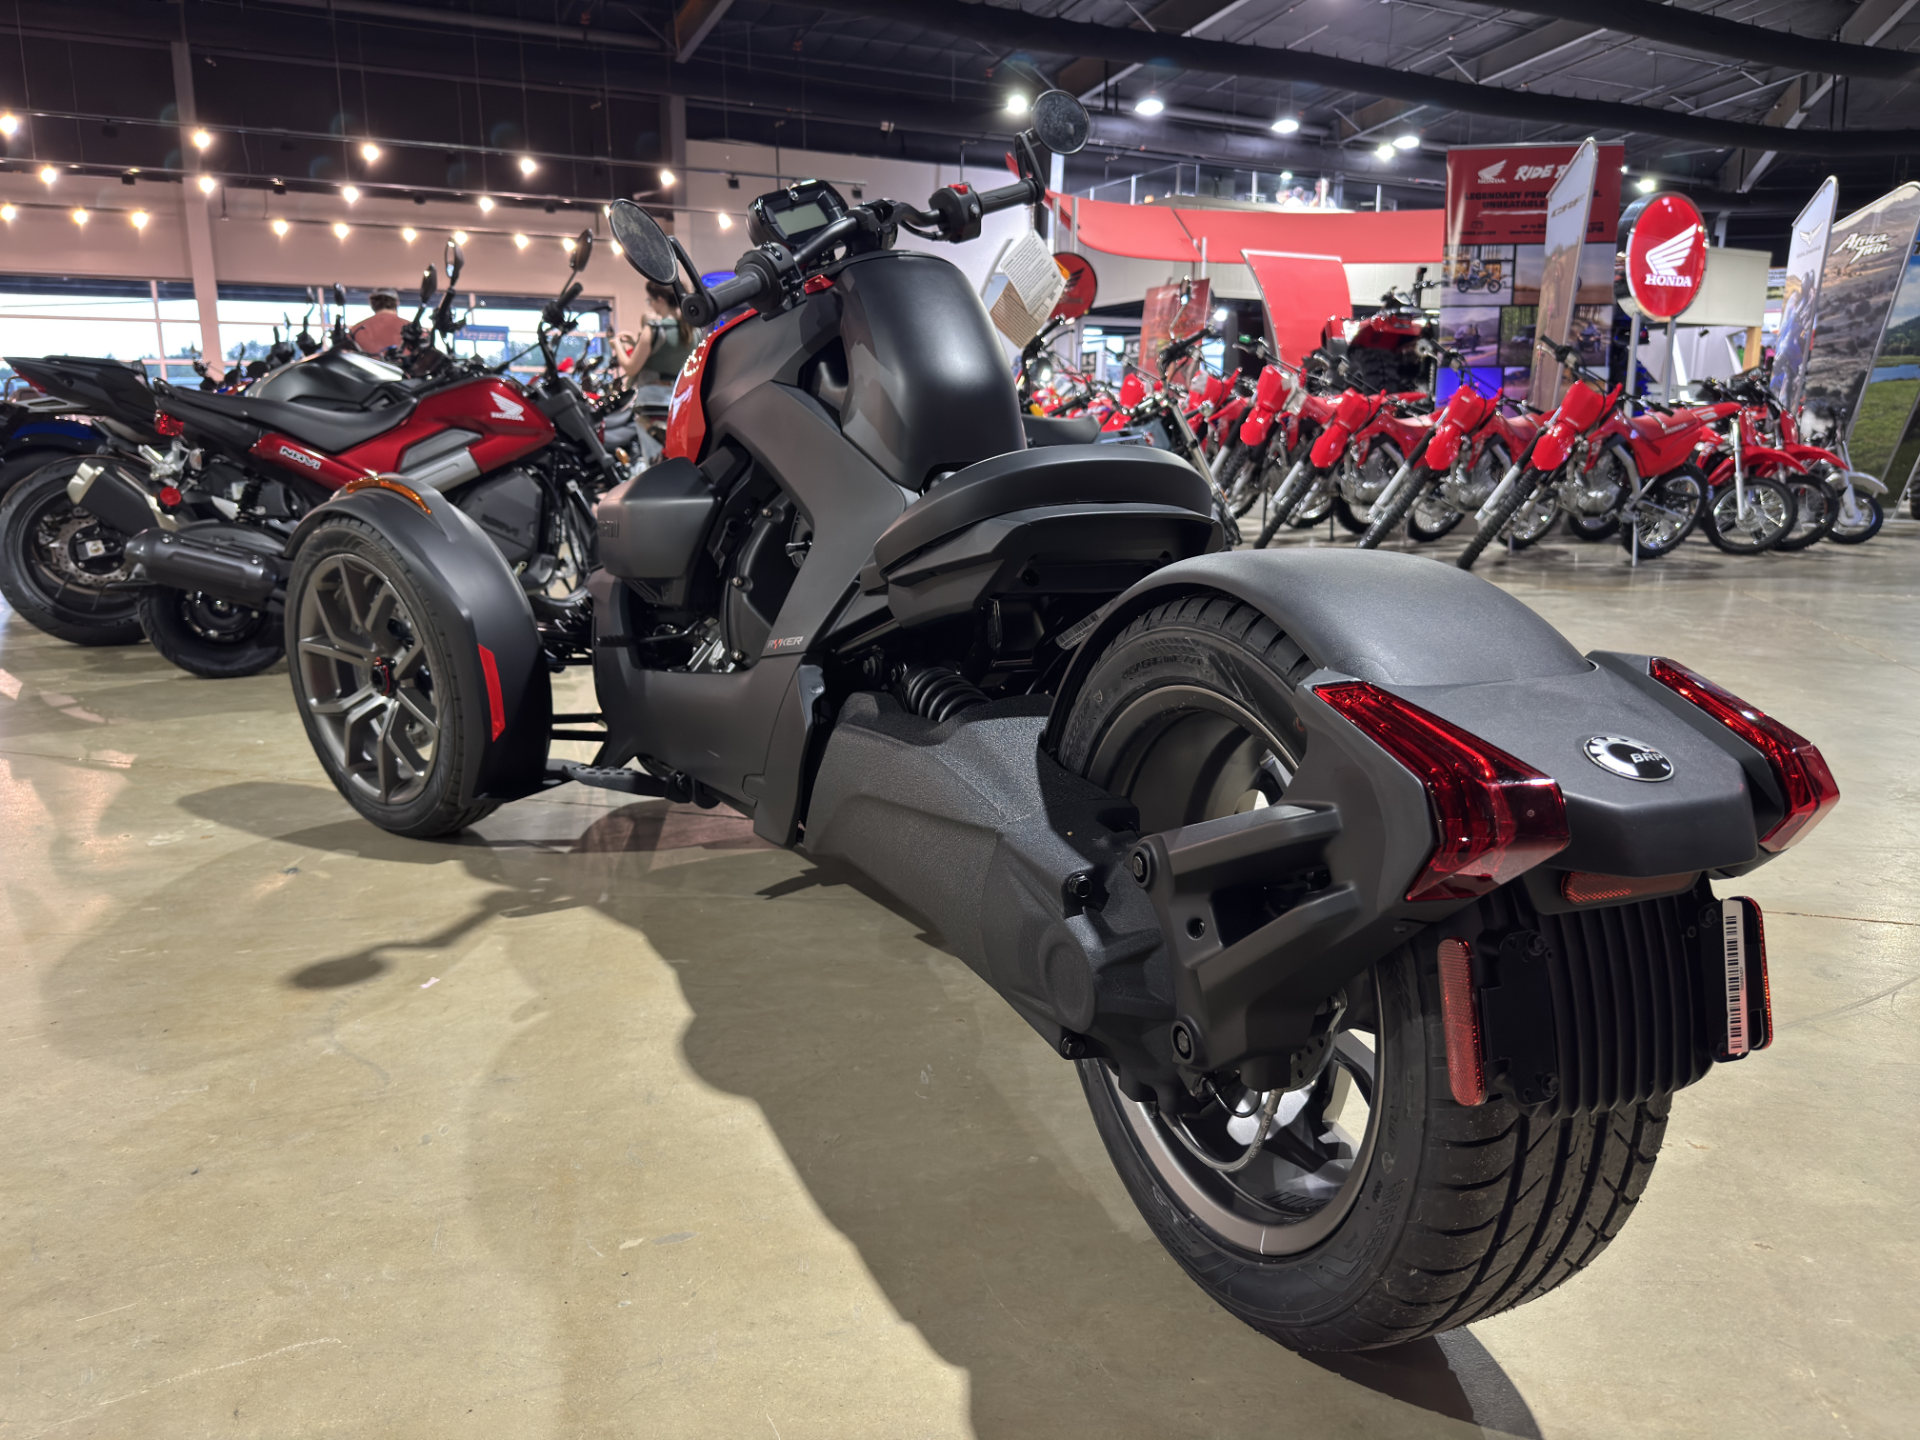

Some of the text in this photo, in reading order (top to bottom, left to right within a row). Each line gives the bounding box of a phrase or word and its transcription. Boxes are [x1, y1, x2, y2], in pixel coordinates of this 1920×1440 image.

[1514, 164, 1555, 182] RIDE
[1832, 232, 1893, 255] Africa
[1848, 243, 1896, 265] Twin
[1644, 273, 1693, 288] HONDA
[767, 636, 804, 650] RYKER
[1630, 752, 1663, 764] BRP
